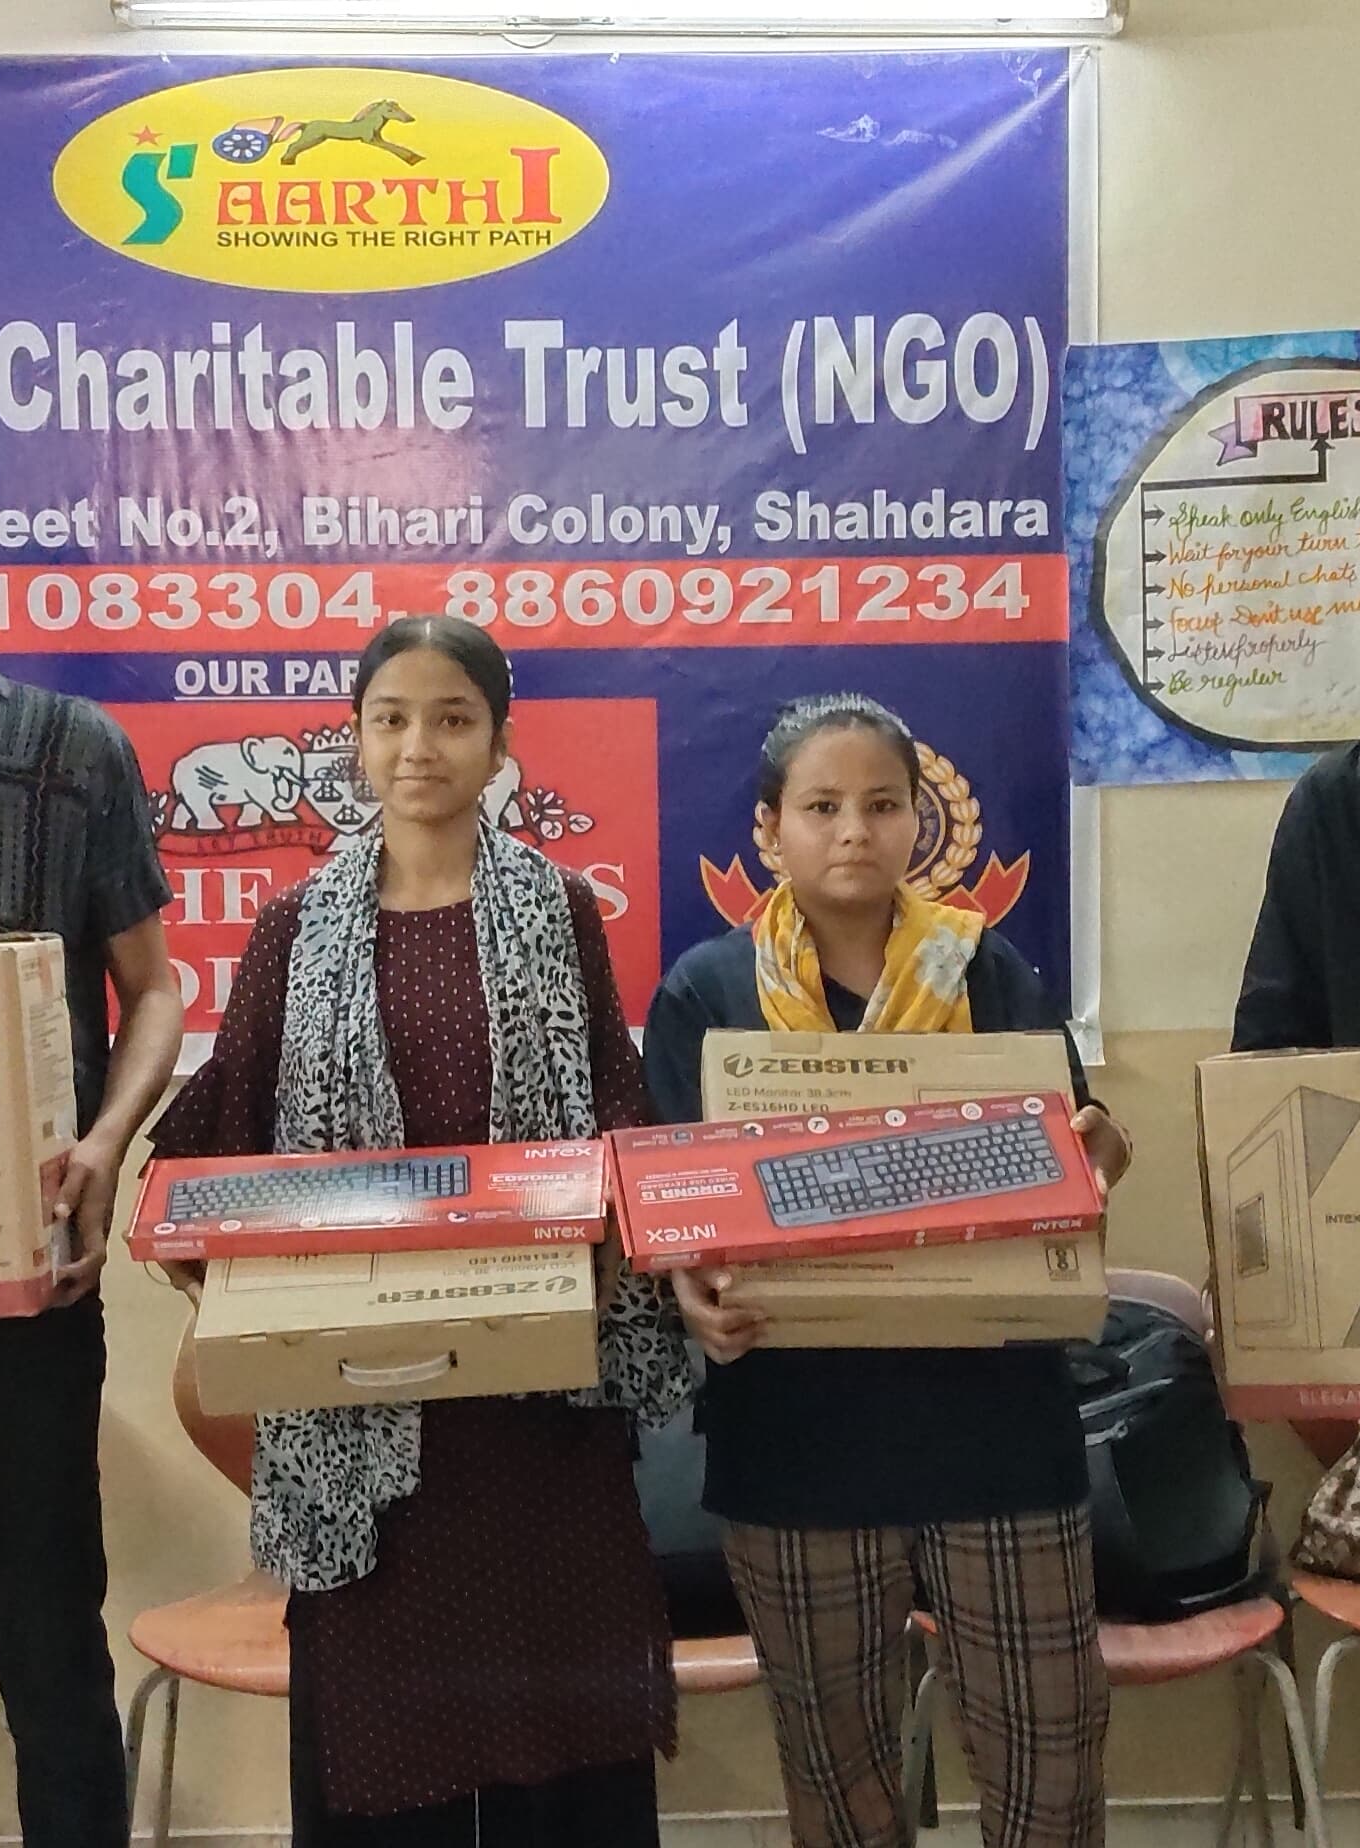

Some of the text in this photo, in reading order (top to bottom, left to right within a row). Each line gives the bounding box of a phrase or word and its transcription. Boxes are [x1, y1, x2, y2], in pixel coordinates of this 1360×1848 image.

[216, 229, 552, 249] SHOWING THE RIGHT PATH
[504, 316, 749, 429] Trust
[781, 311, 1050, 454] (NGO)
[118, 496, 280, 559] No.2,
[302, 494, 484, 548] Bihari
[506, 493, 733, 556] Colony,
[754, 489, 1049, 540] Shahdara
[1239, 497, 1285, 545] only
[1296, 531, 1350, 554] turn
[445, 561, 1031, 628] 8860921234
[1167, 569, 1194, 599] No
[174, 659, 271, 695] OUR
[1168, 669, 1193, 695] Be
[160, 867, 273, 925] HE
